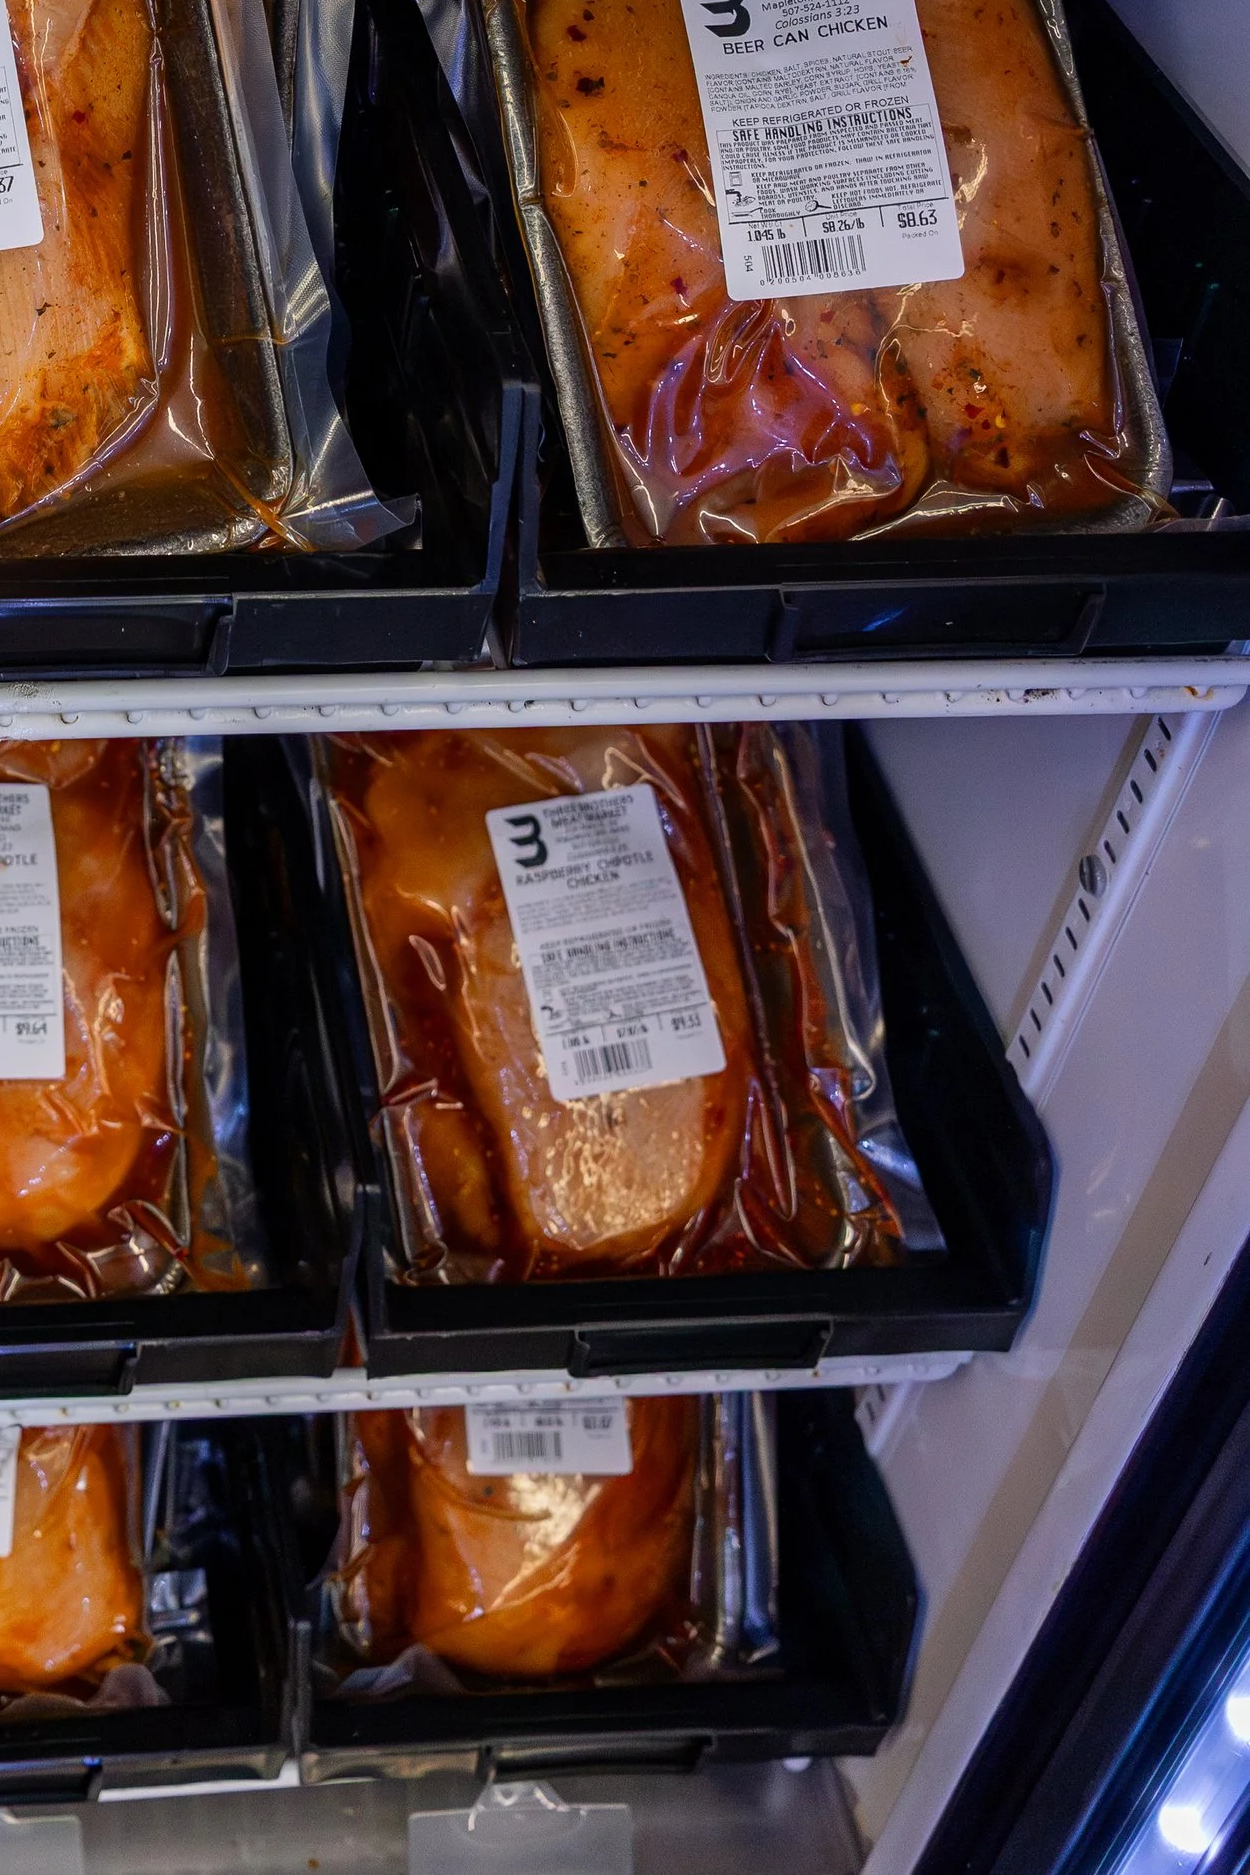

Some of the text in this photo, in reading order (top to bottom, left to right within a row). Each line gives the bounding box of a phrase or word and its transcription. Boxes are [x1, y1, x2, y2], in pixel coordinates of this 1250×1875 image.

[775, 4, 860, 30] Colossians 3:23
[722, 15, 888, 55] BEER CAN CHICKEN
[731, 94, 909, 127] KEEP REFRIGERATED OR FROZEN
[732, 105, 912, 144] SAFE HANDLING INSTRUCTIONS
[747, 208, 937, 242] 1.045 lb $8.26/lb $8.63
